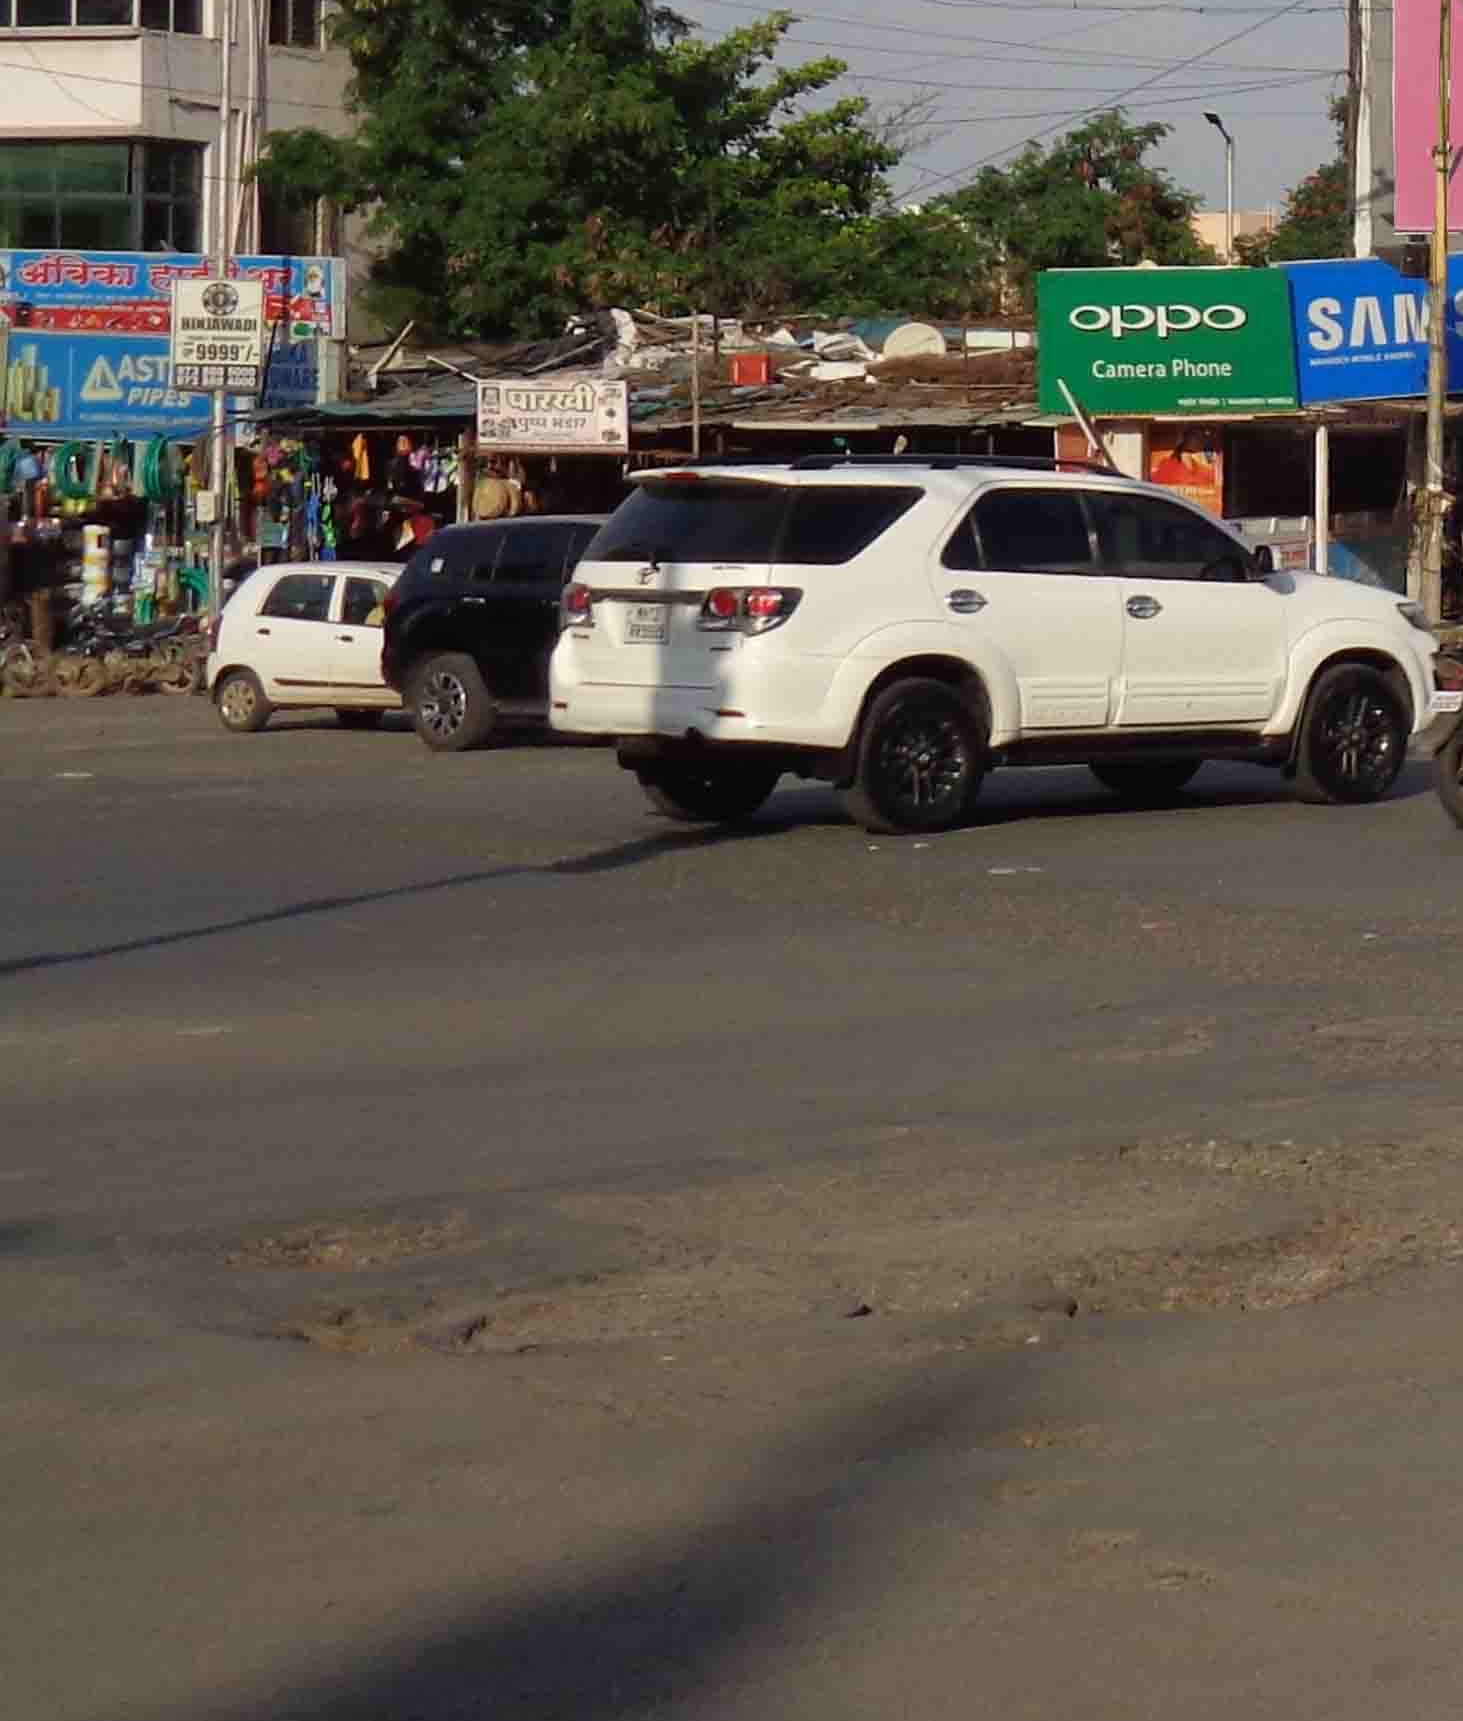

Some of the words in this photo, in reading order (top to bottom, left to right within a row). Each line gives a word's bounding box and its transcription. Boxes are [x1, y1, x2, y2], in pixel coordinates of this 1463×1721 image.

[1091, 359, 1167, 380] Camera
[1172, 359, 1233, 378] Phone
[127, 387, 193, 408] PIPES
